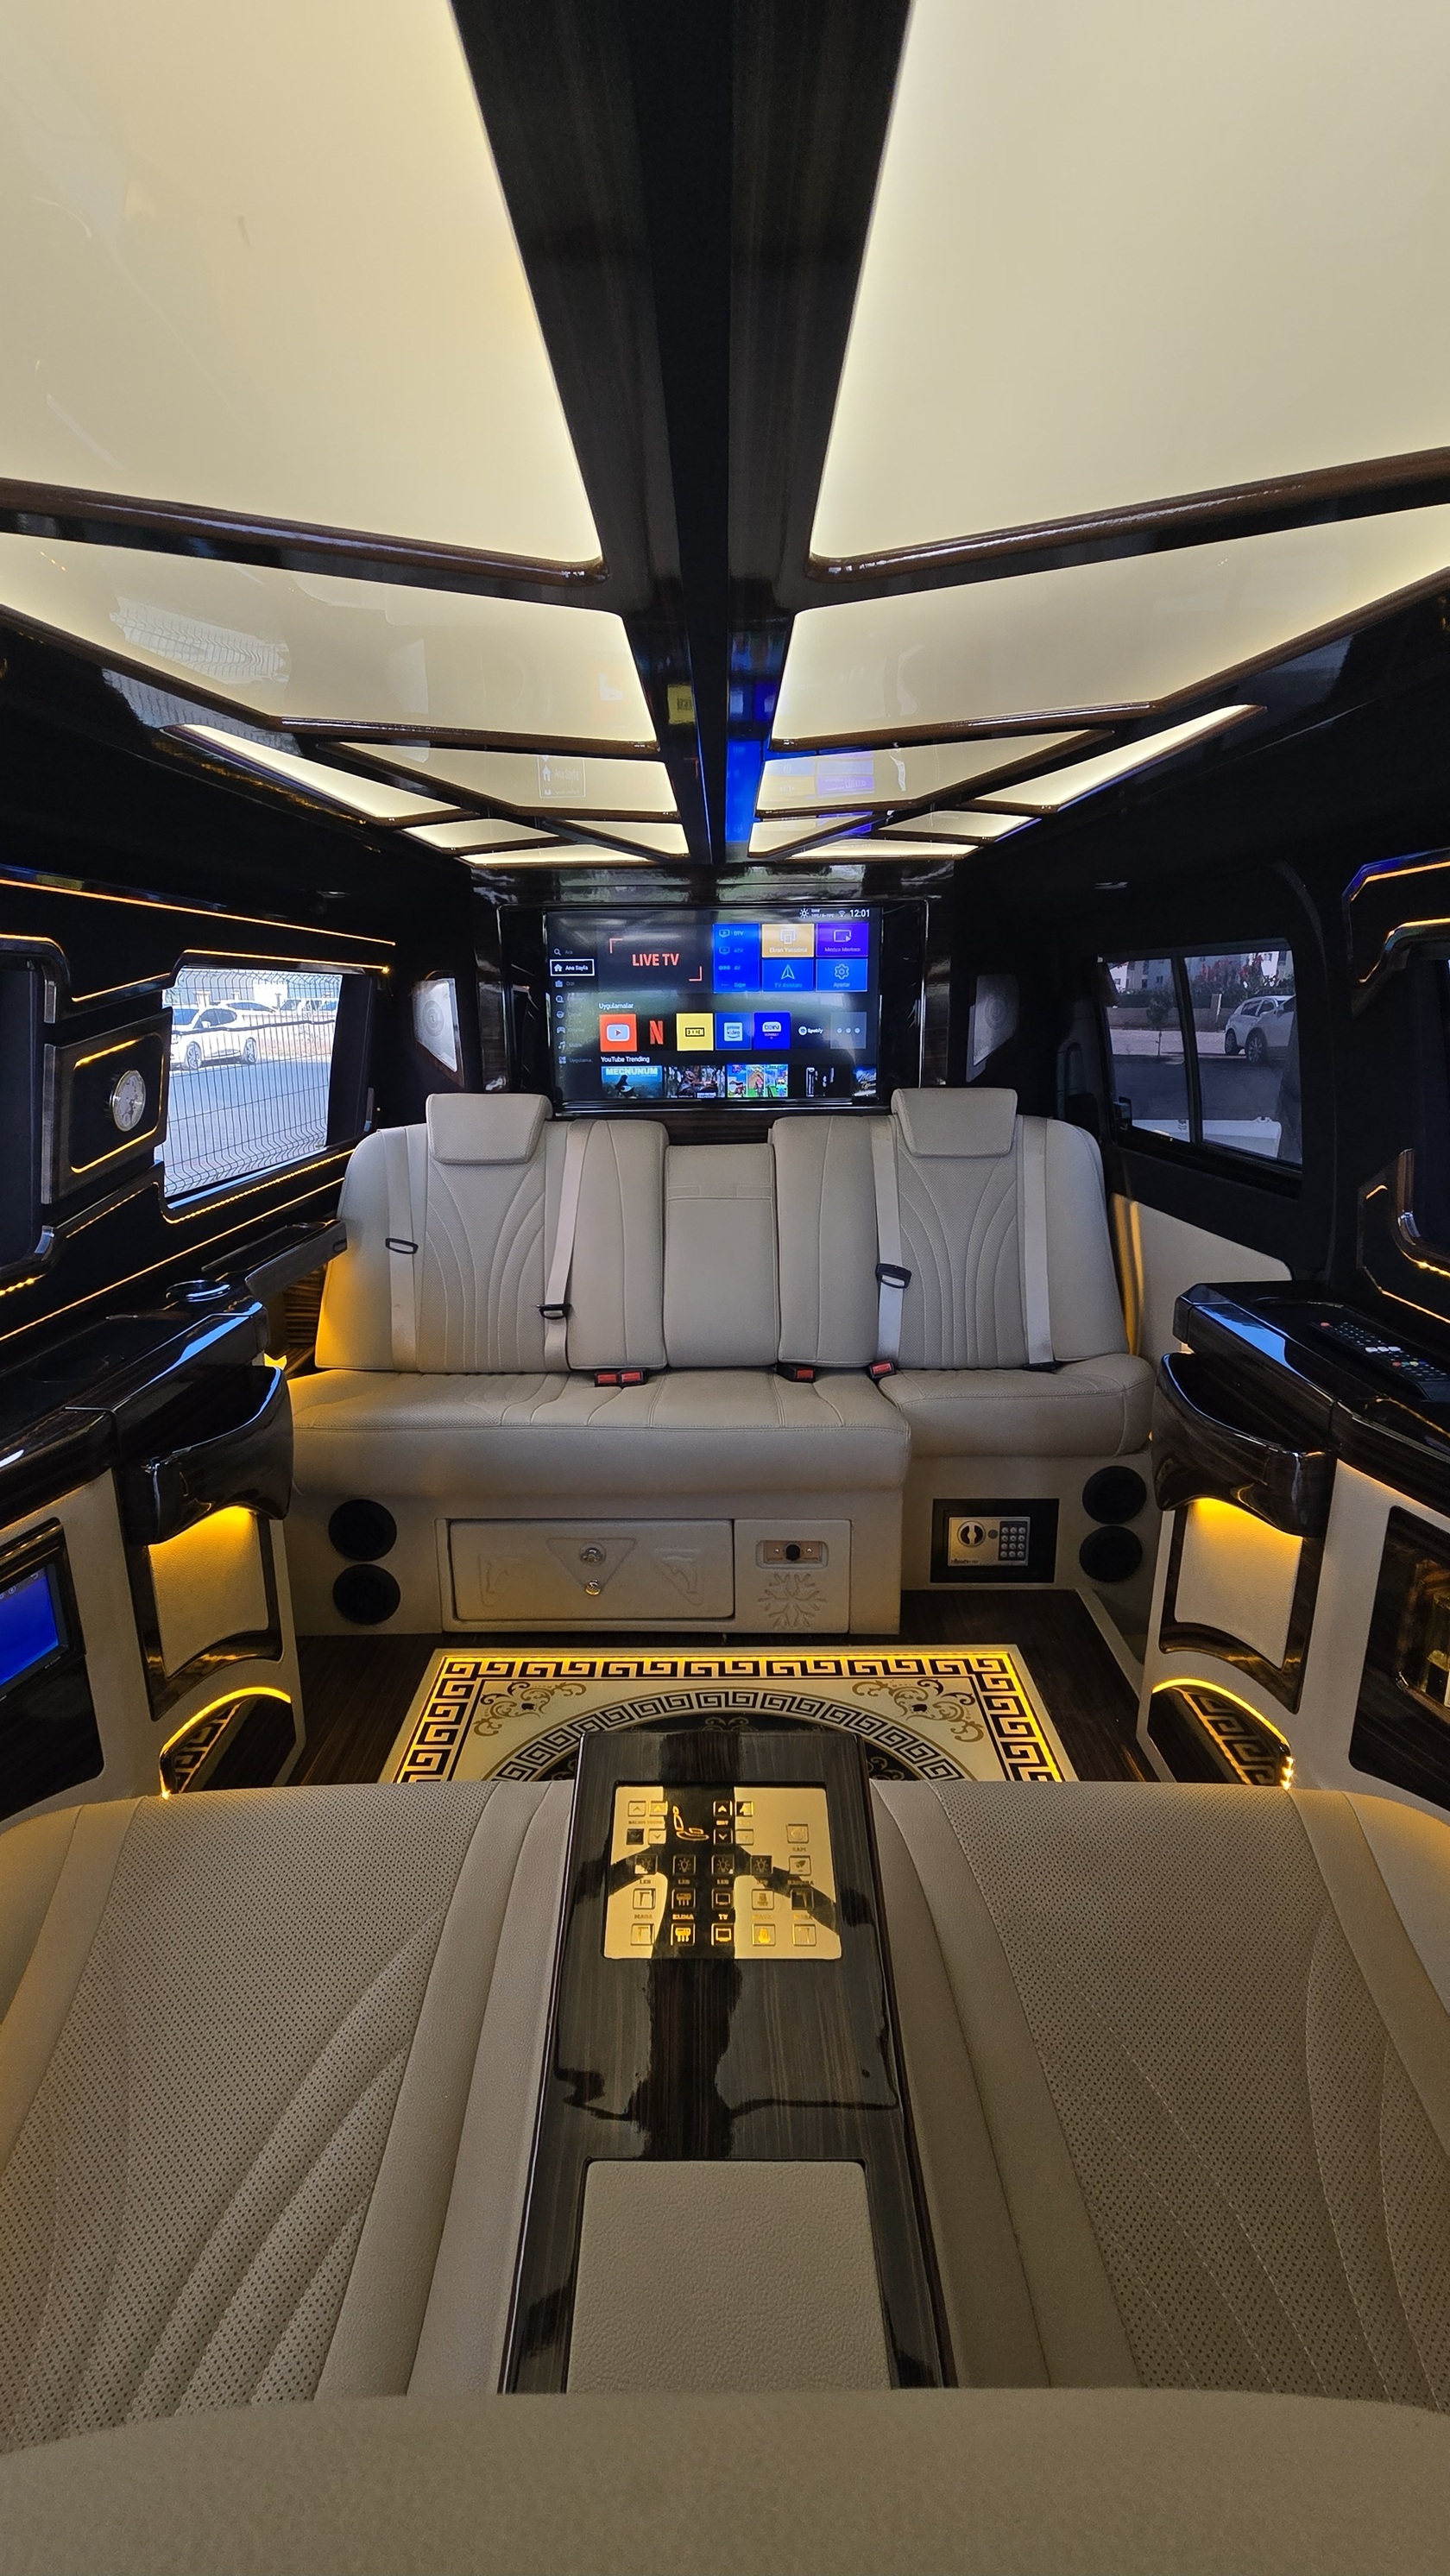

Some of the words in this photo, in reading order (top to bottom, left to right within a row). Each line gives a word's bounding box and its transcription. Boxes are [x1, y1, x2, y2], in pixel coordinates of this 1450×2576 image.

[849, 909, 870, 918] 12:01
[633, 953, 659, 966] LIVE
[662, 953, 679, 966] TV
[649, 1020, 664, 1045] N
